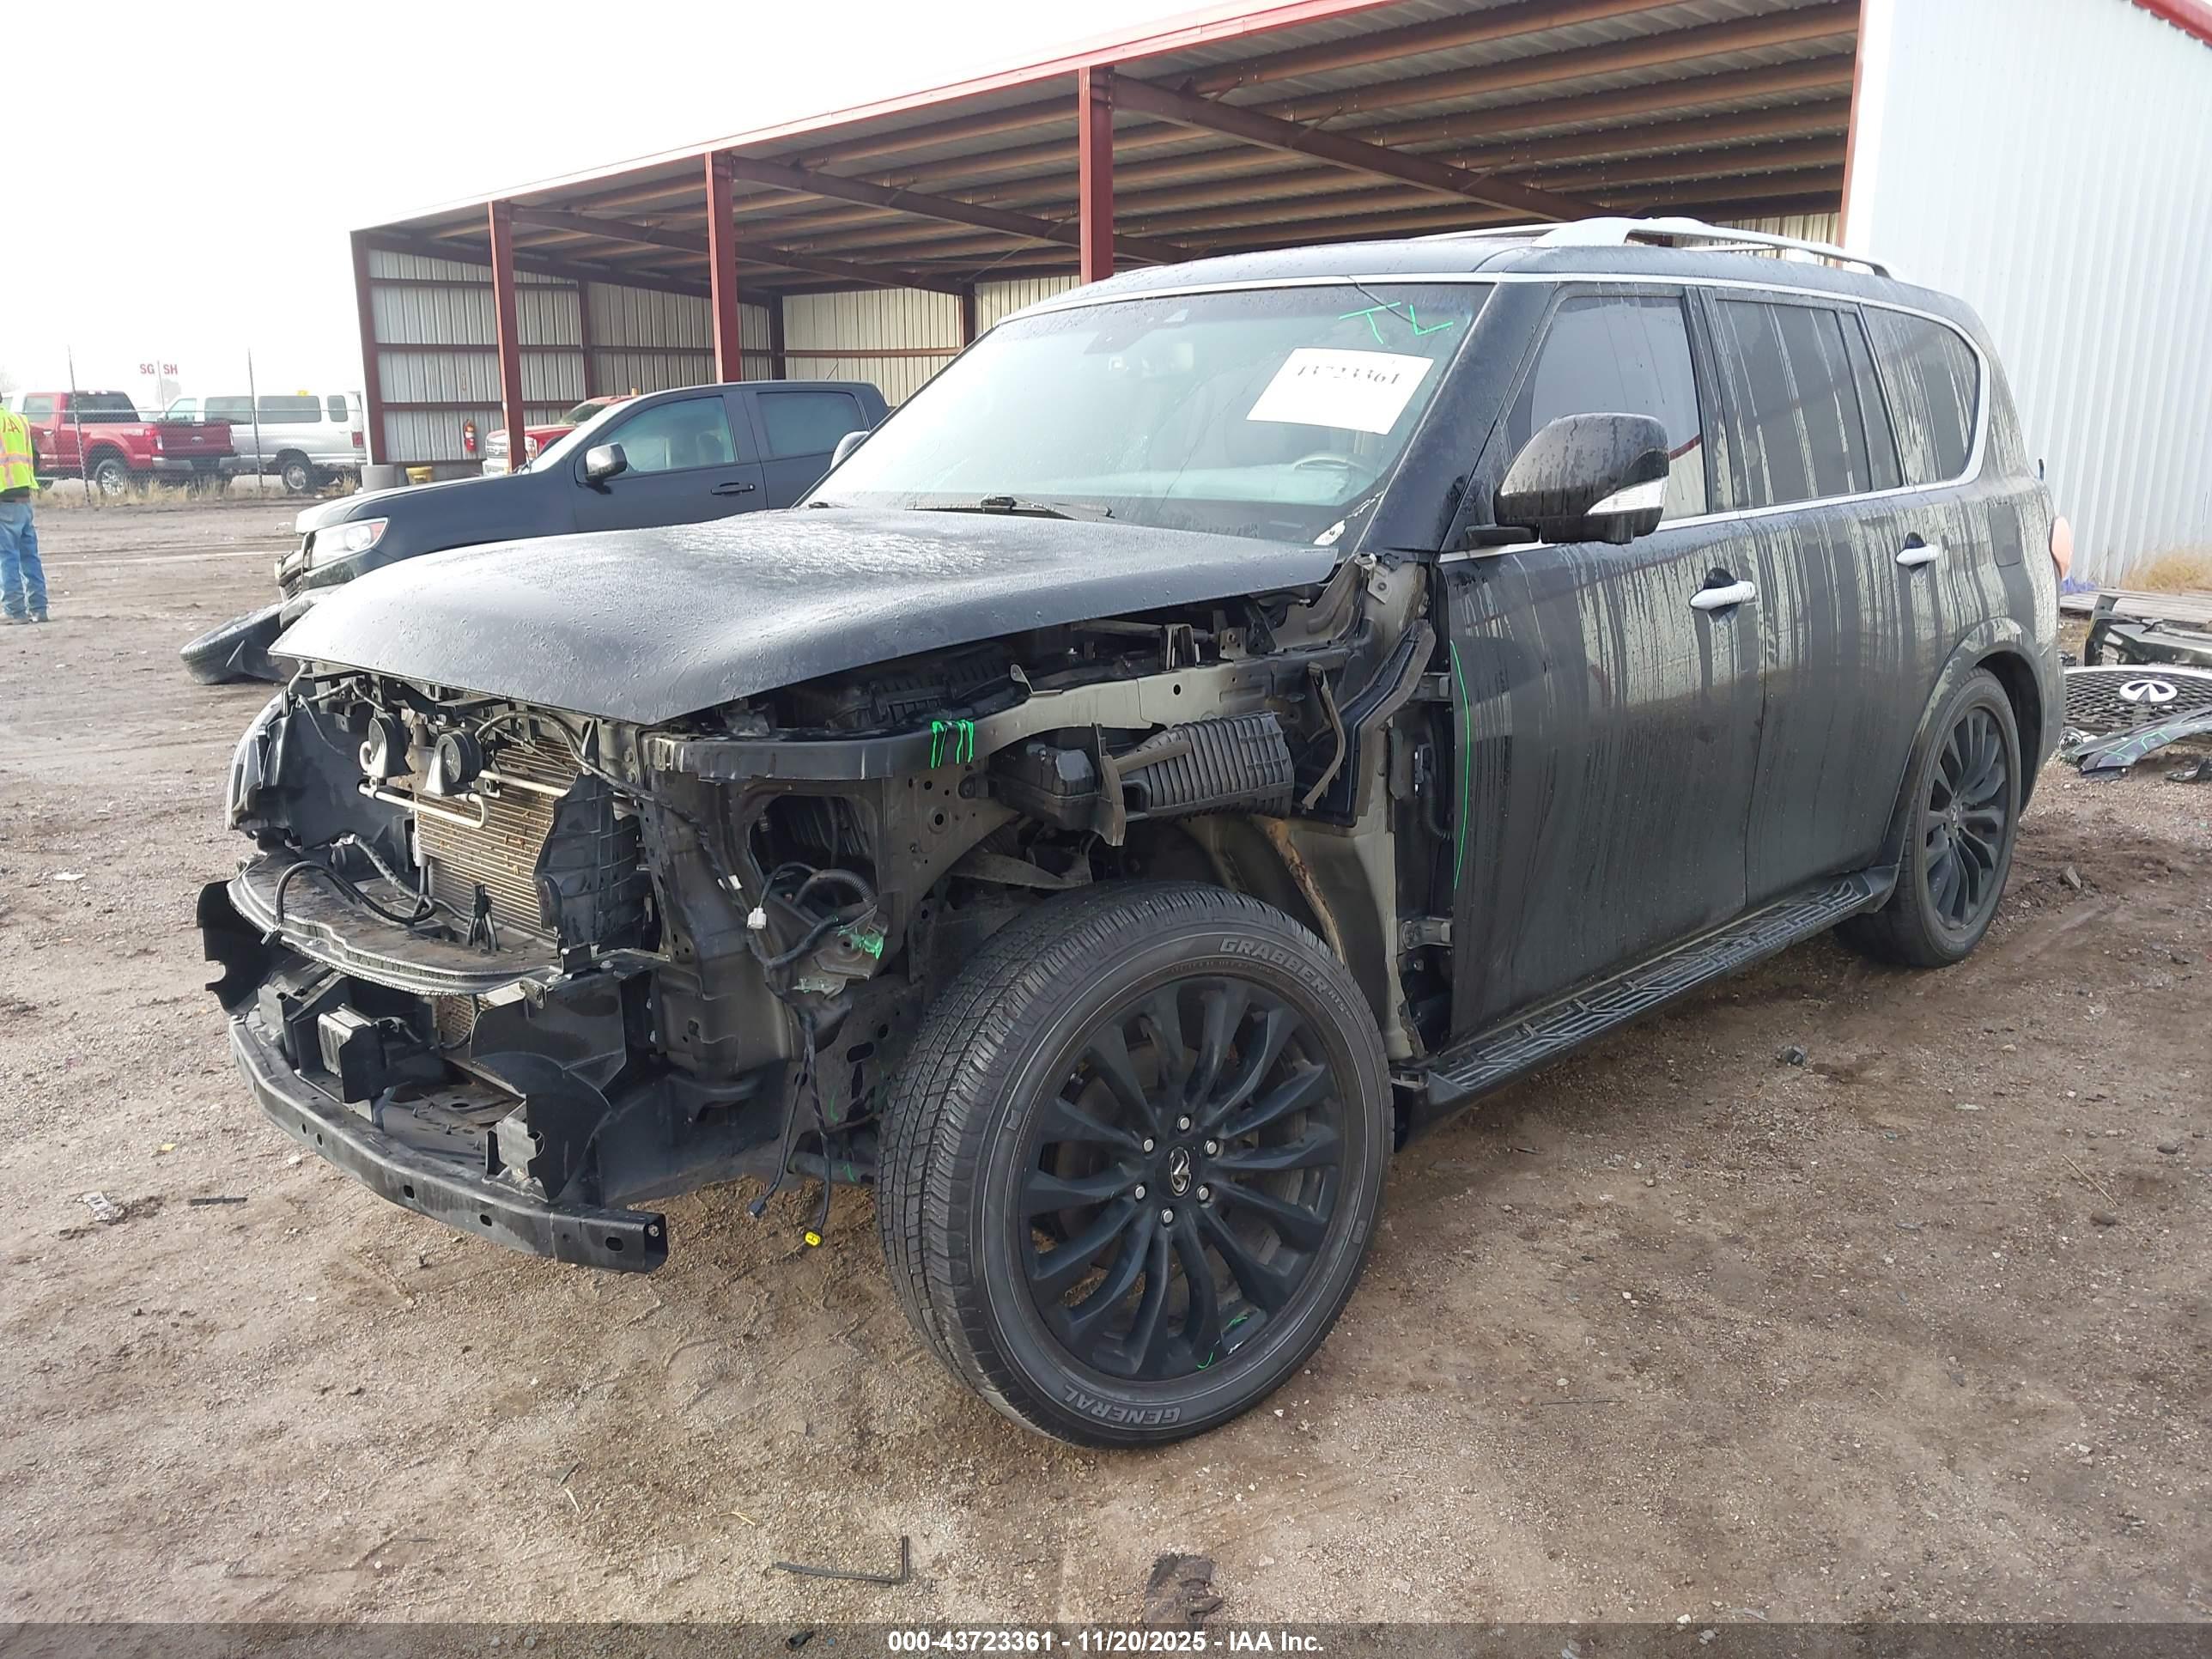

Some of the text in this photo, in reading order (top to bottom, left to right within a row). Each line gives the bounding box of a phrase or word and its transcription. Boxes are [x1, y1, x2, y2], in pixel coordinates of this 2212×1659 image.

[139, 363, 155, 375] SG
[162, 363, 179, 375] SH
[1219, 937, 1328, 994] GRABBER
[1064, 1383, 1182, 1425] GENERAL
